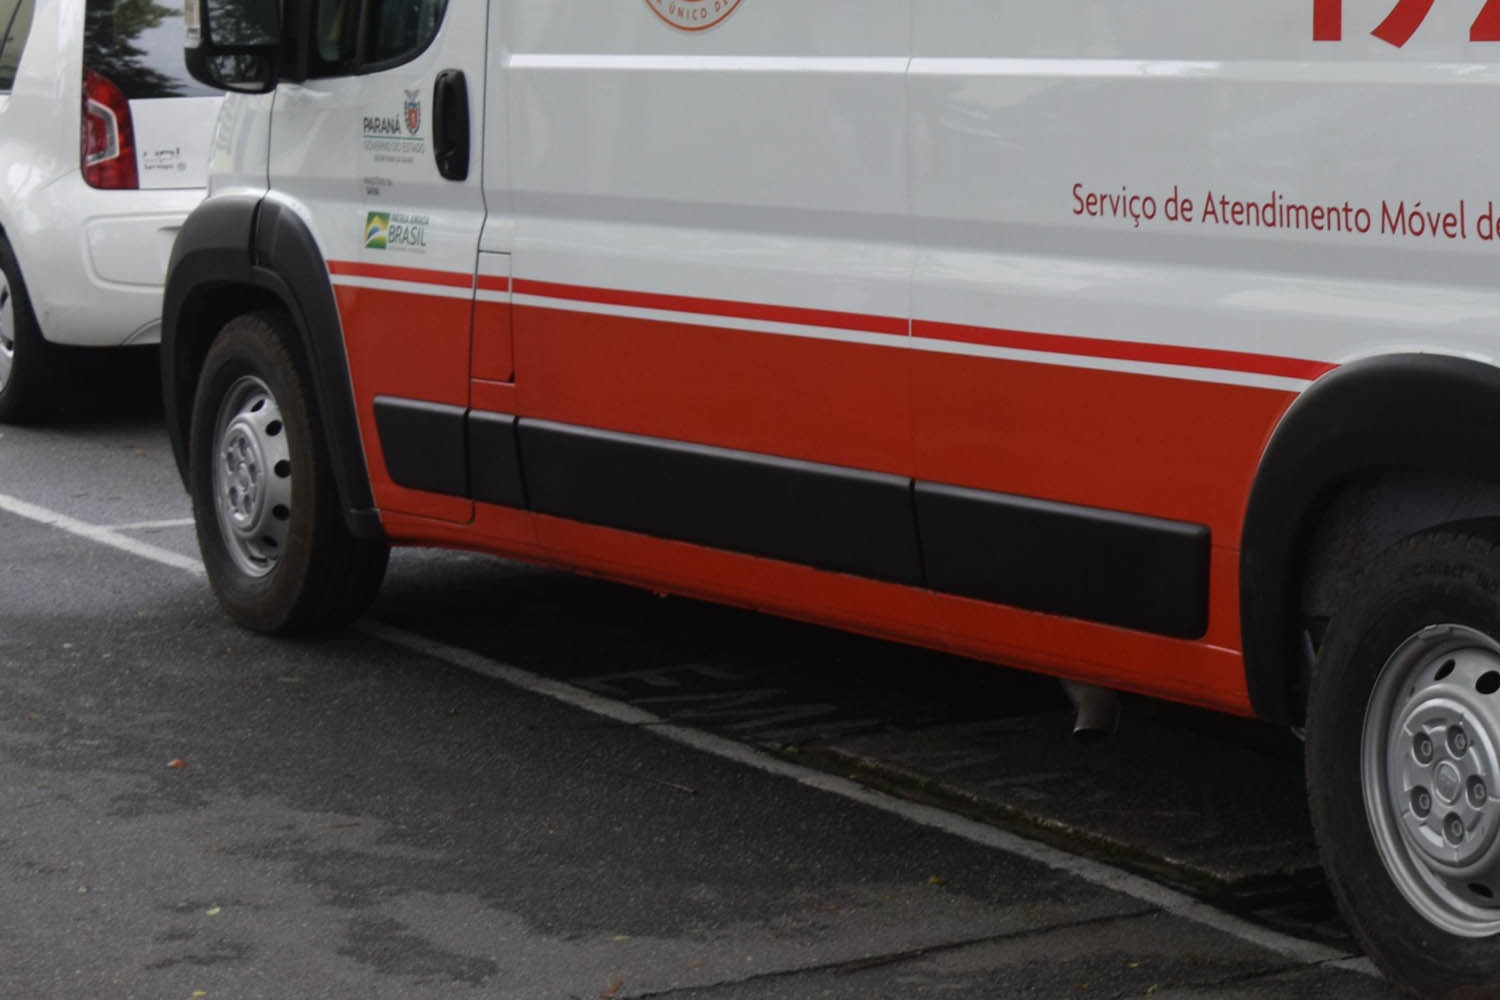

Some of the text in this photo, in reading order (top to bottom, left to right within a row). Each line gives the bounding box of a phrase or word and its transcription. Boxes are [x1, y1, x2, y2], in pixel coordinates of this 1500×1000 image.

[363, 114, 401, 134] PARANÁ
[1072, 183, 1157, 227] Serviço
[1164, 185, 1193, 223] de
[1202, 190, 1371, 233] Atendimento
[1381, 200, 1466, 239] Móvel
[388, 225, 426, 247] BRASIL
